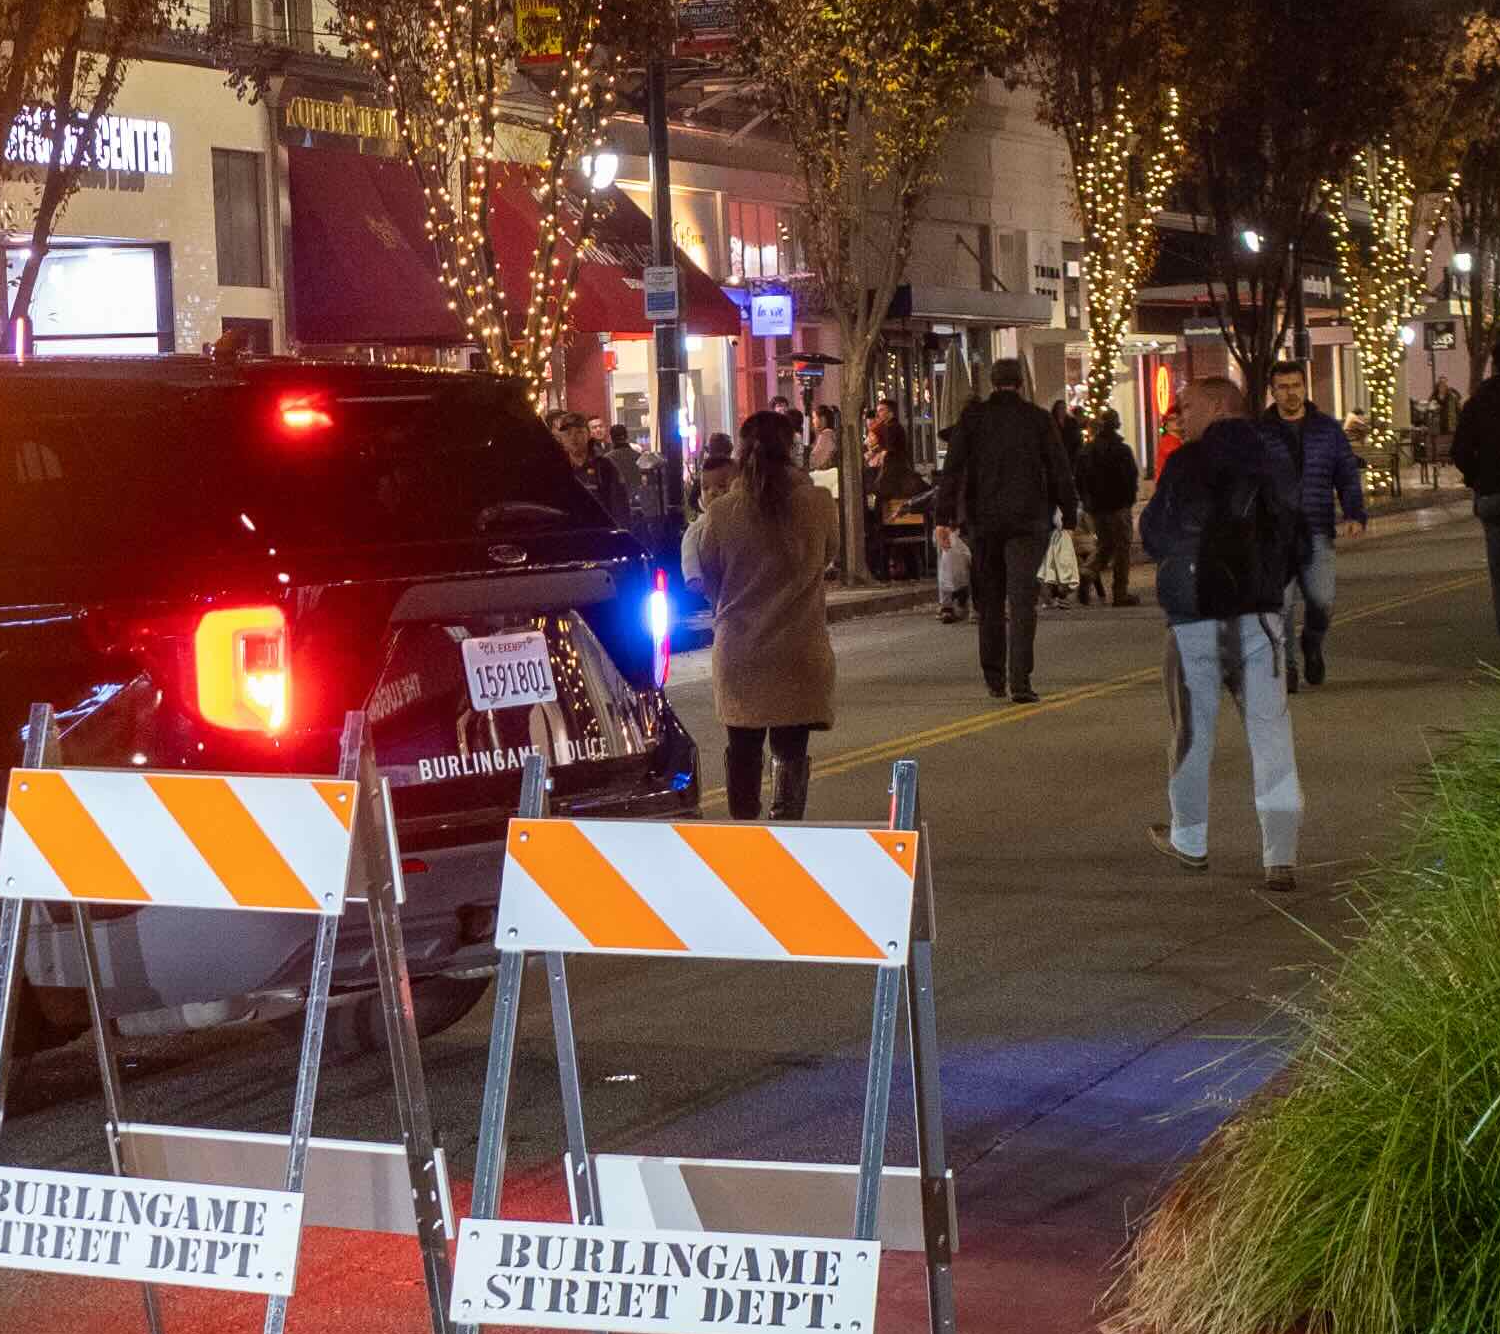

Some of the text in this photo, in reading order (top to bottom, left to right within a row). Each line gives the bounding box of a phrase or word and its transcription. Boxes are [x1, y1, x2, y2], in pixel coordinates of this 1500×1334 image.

[96, 114, 173, 174] CENTER
[476, 659, 551, 700] 1591801
[145, 1234, 263, 1280] DEPT.
[495, 1232, 841, 1287] BURLINGAME
[483, 1274, 841, 1331] STREET DEPT.
